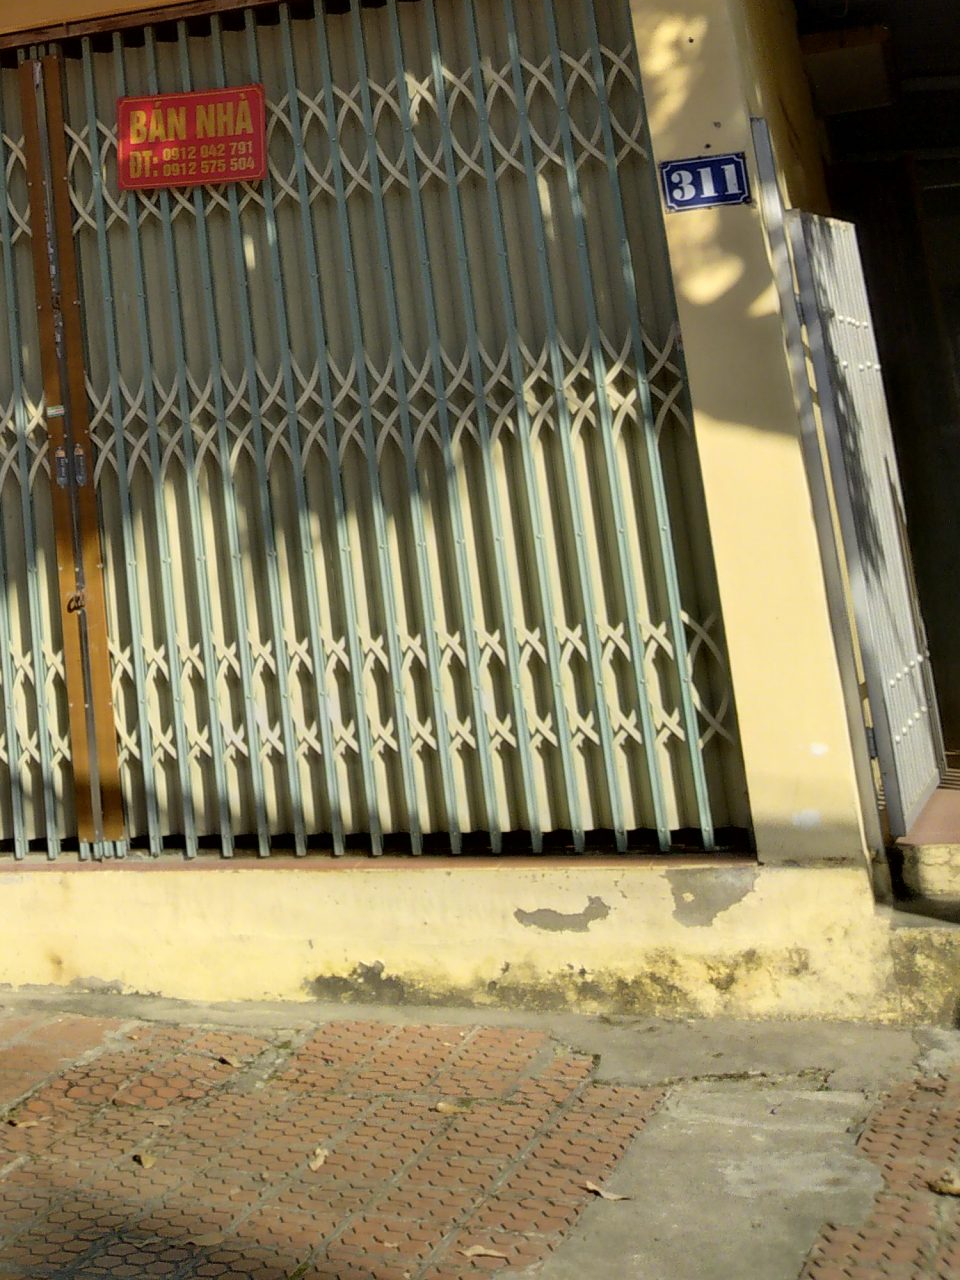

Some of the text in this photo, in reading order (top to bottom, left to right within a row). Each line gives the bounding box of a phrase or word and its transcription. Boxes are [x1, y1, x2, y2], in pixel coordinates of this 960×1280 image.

[129, 101, 187, 145] BÁN
[162, 146, 197, 162] 0912
[229, 140, 253, 156] 791
[163, 161, 197, 177] 0912
[201, 159, 226, 174] 575
[671, 164, 743, 201] 311
